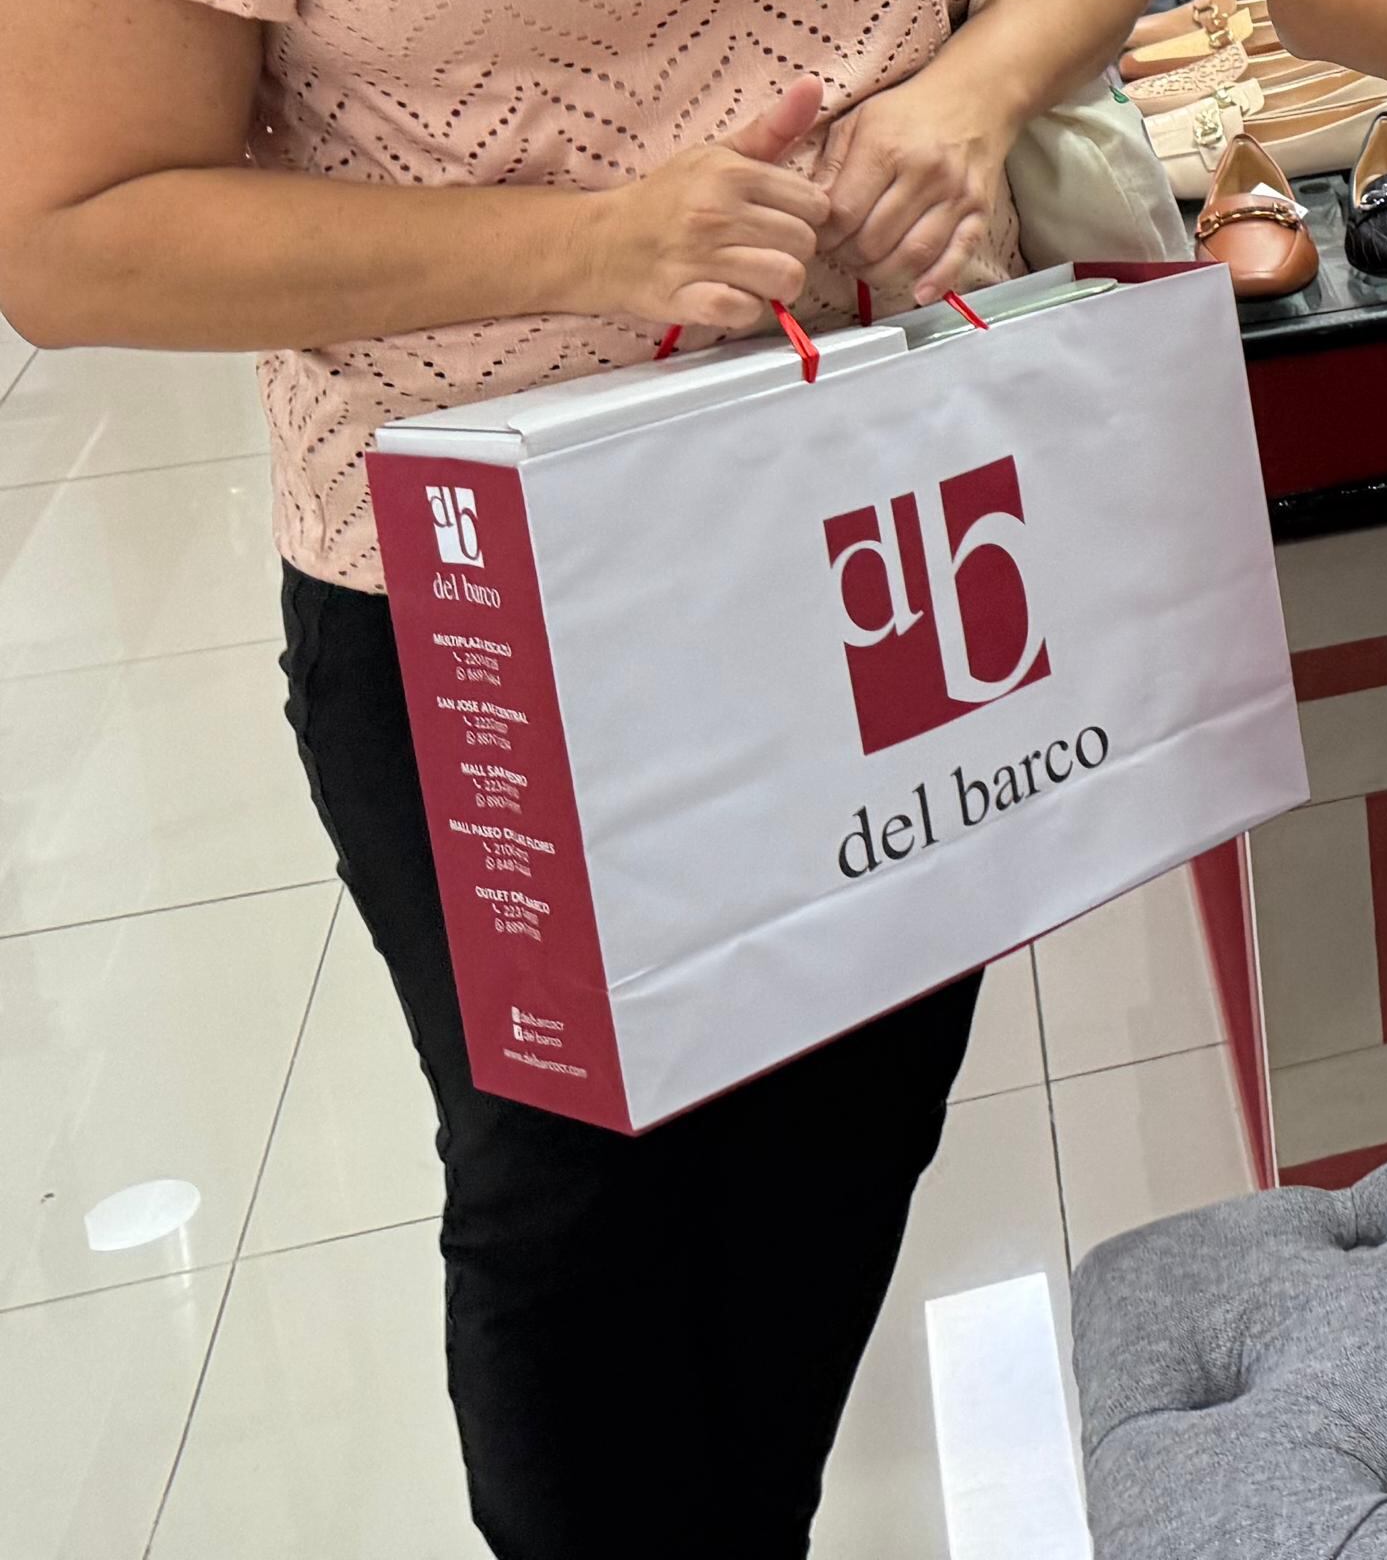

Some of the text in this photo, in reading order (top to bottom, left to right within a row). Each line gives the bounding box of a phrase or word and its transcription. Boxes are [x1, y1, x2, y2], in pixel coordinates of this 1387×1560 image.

[433, 572, 460, 601] del
[838, 726, 1109, 878] del barco
